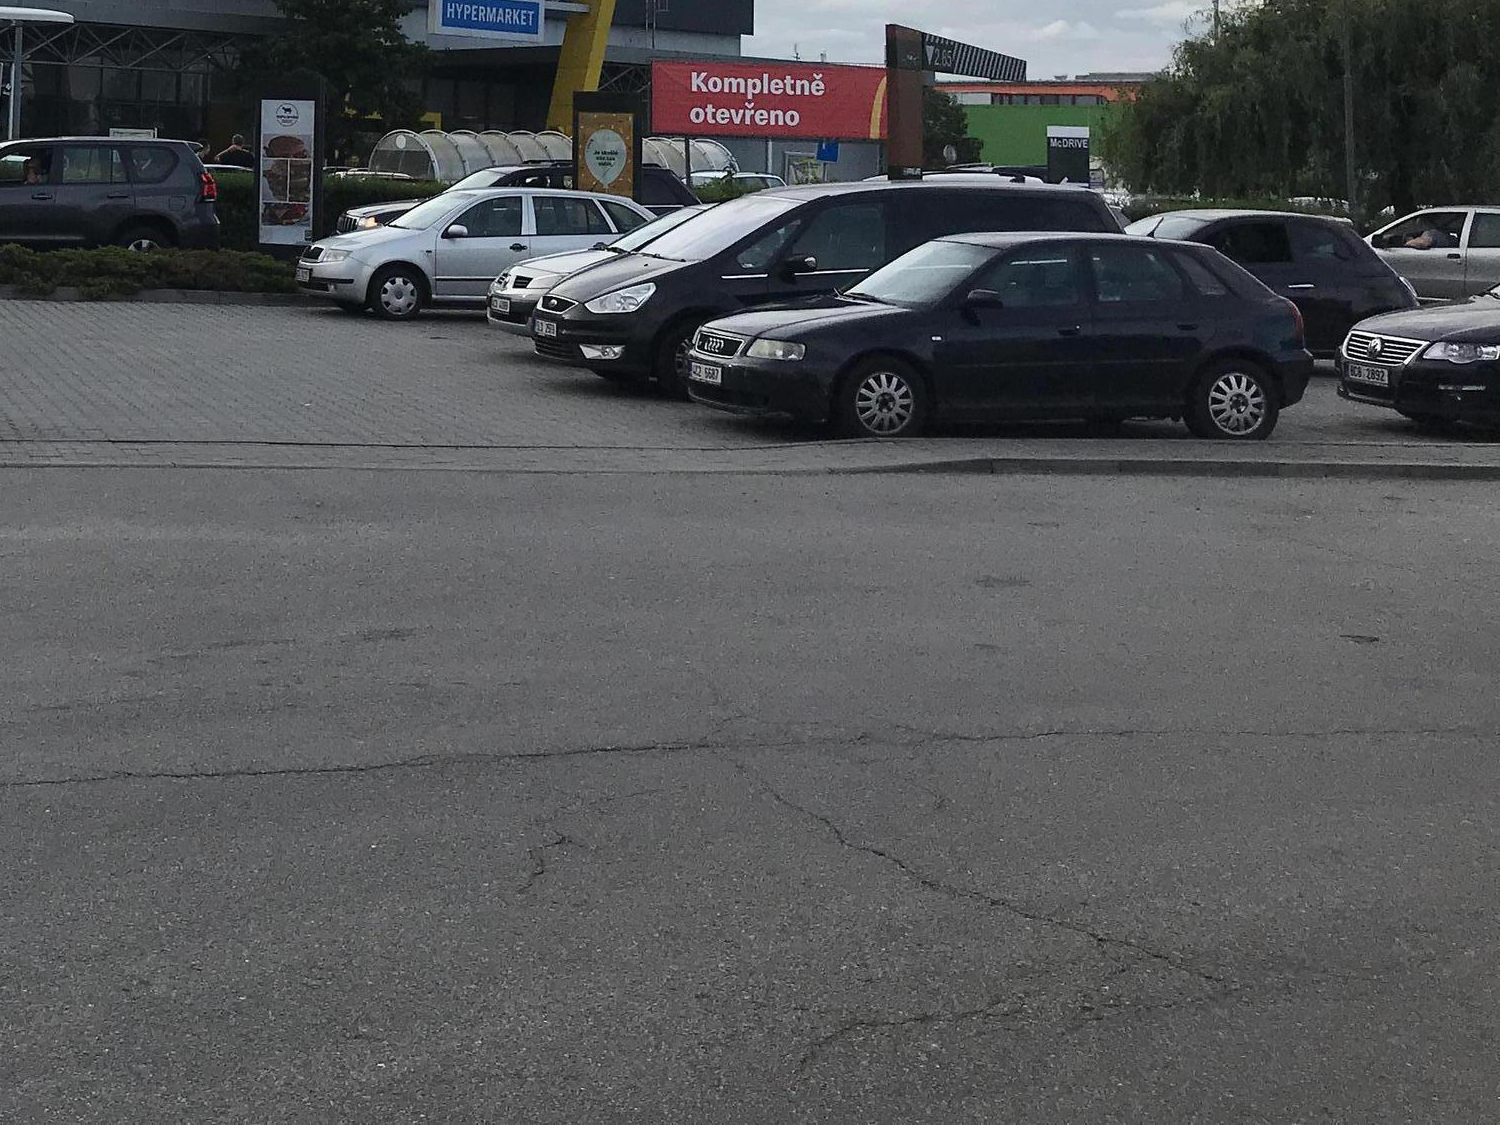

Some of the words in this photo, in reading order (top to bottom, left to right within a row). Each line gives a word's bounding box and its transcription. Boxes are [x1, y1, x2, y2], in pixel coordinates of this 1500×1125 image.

[446, 2, 535, 27] HYPERMARKET
[691, 71, 826, 99] Kompletně
[689, 102, 800, 127] otevřeno
[1050, 138, 1089, 148] McDRIVE
